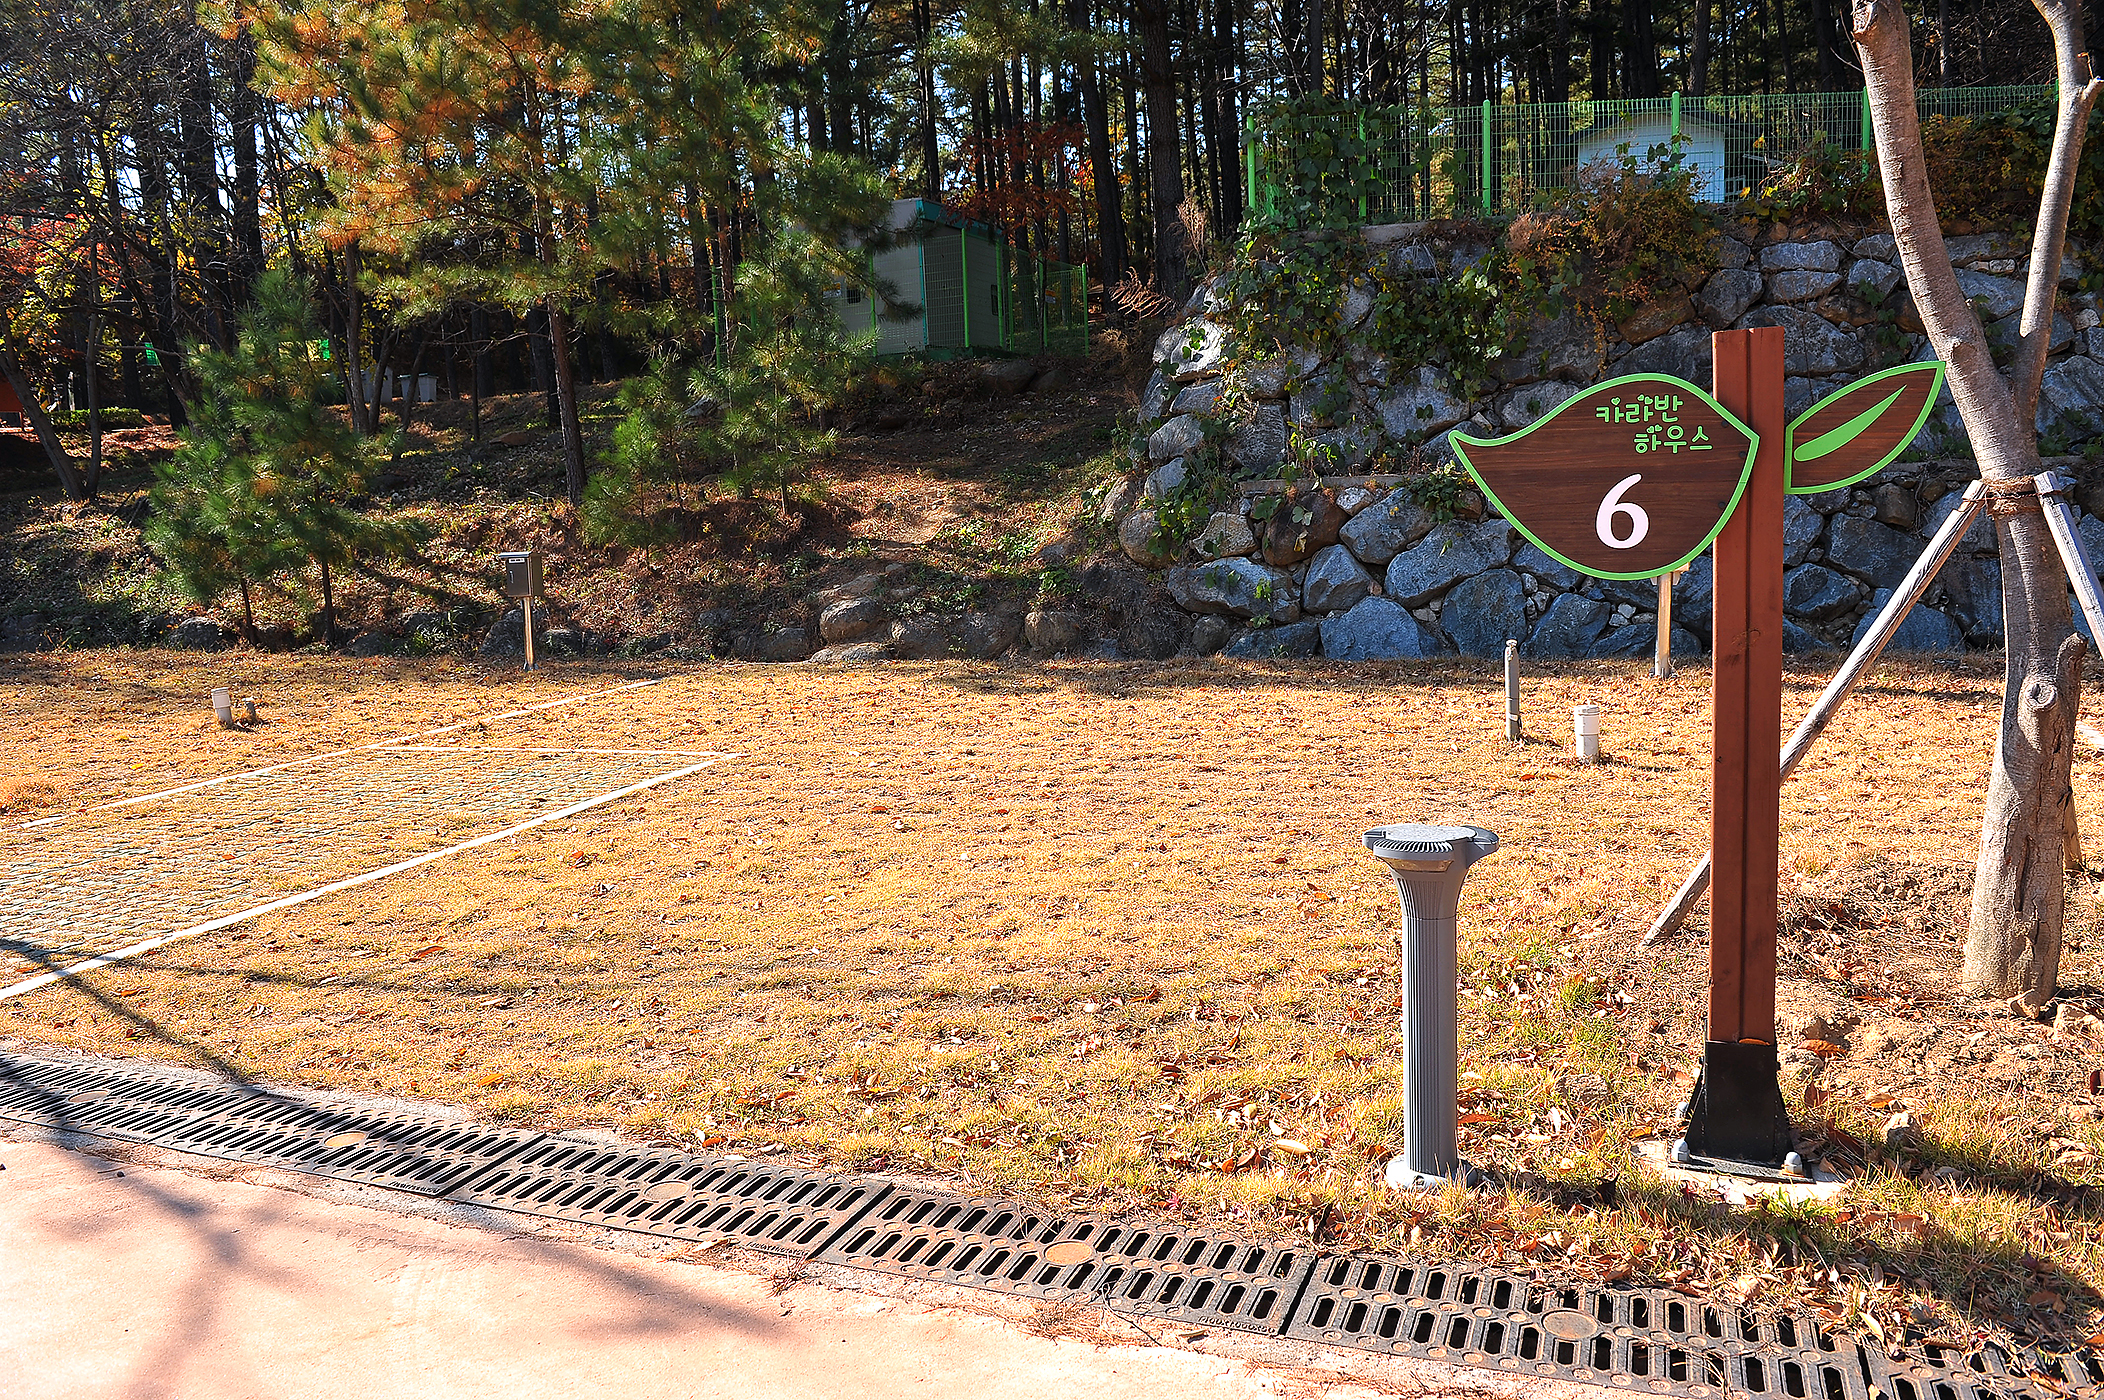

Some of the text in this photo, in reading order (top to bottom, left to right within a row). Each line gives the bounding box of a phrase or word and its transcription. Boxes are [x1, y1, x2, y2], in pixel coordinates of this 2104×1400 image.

[1595, 394, 1684, 423] 카라반
[1634, 424, 1712, 454] 하우스
[1596, 474, 1649, 549] 6
